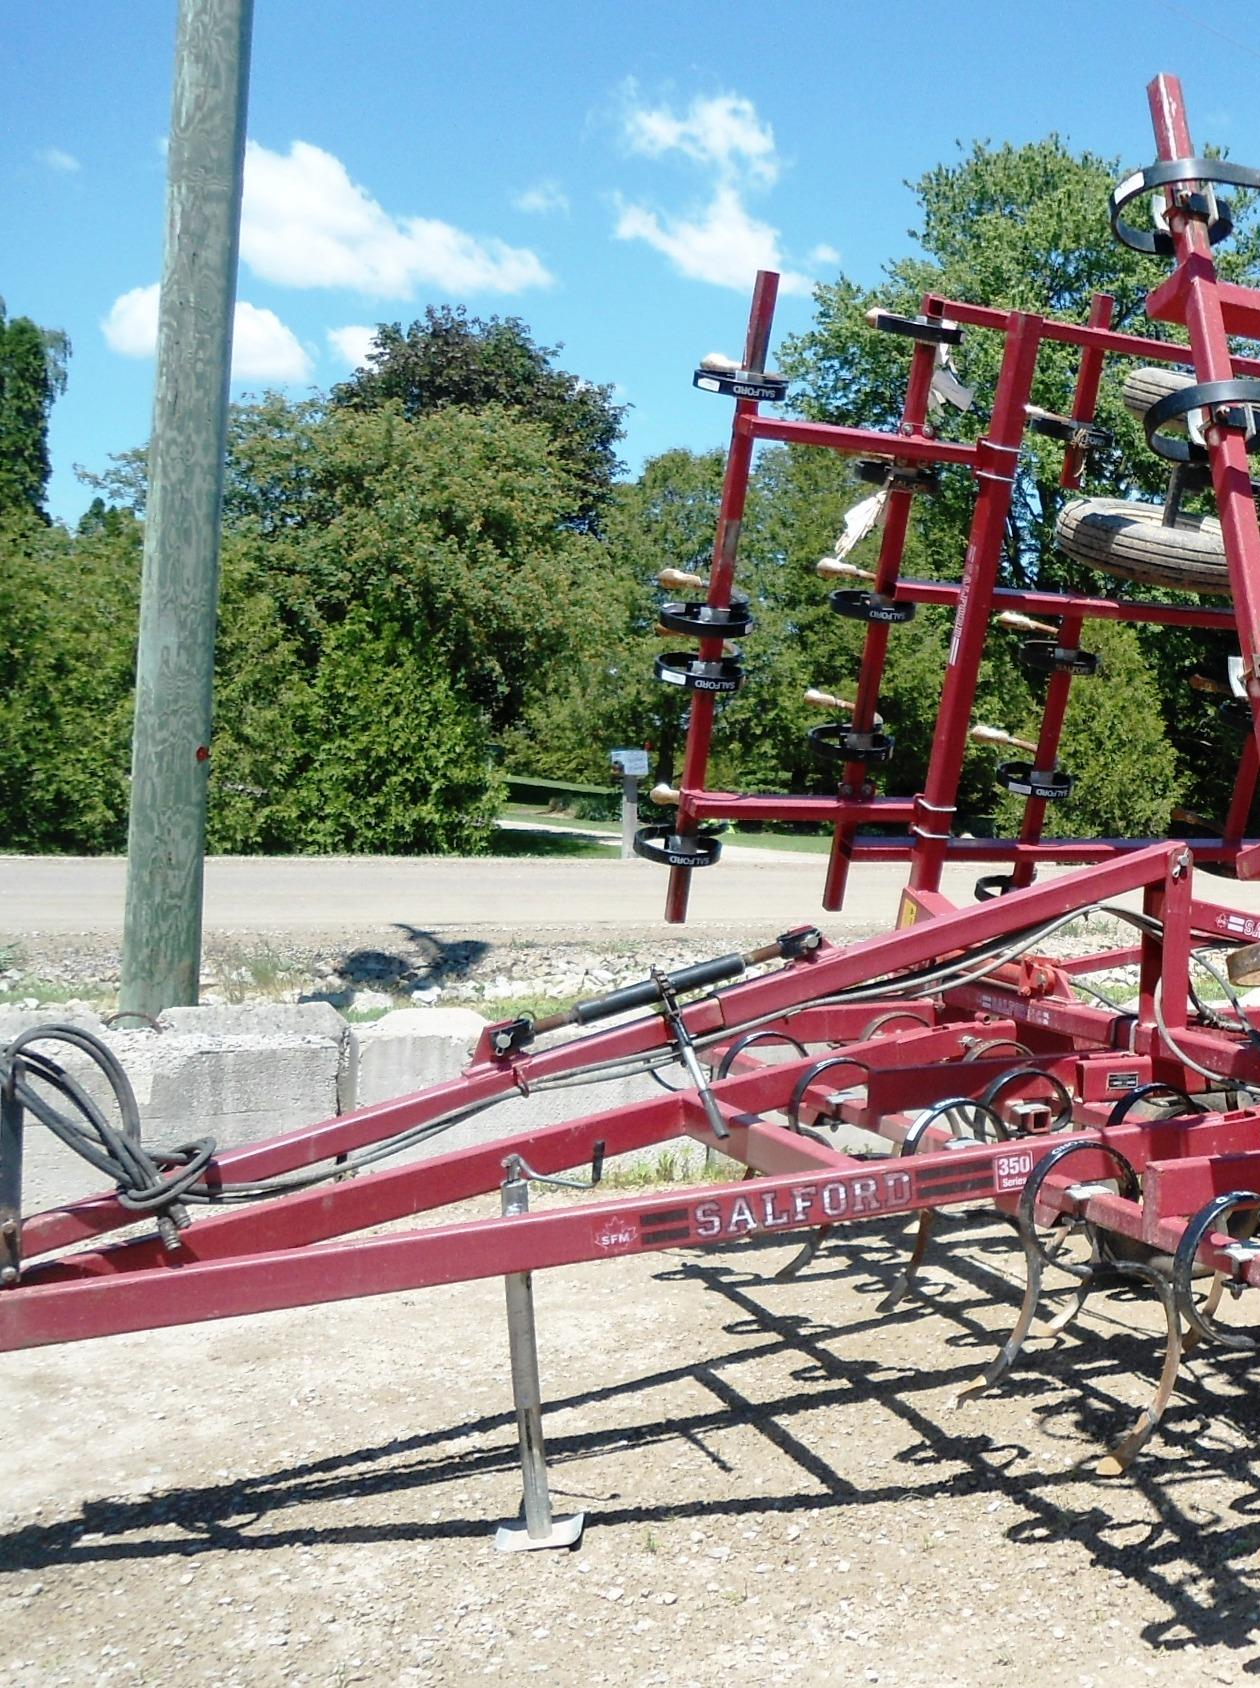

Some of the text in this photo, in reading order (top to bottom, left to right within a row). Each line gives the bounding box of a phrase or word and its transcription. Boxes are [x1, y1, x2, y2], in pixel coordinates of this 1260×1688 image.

[733, 385, 776, 398] SALFORD
[694, 680, 736, 690] SALFORD
[669, 855, 710, 865] SALFORD
[998, 1155, 1030, 1176] 350
[694, 1171, 913, 1238] SALFORD
[601, 1232, 630, 1246] SFM
